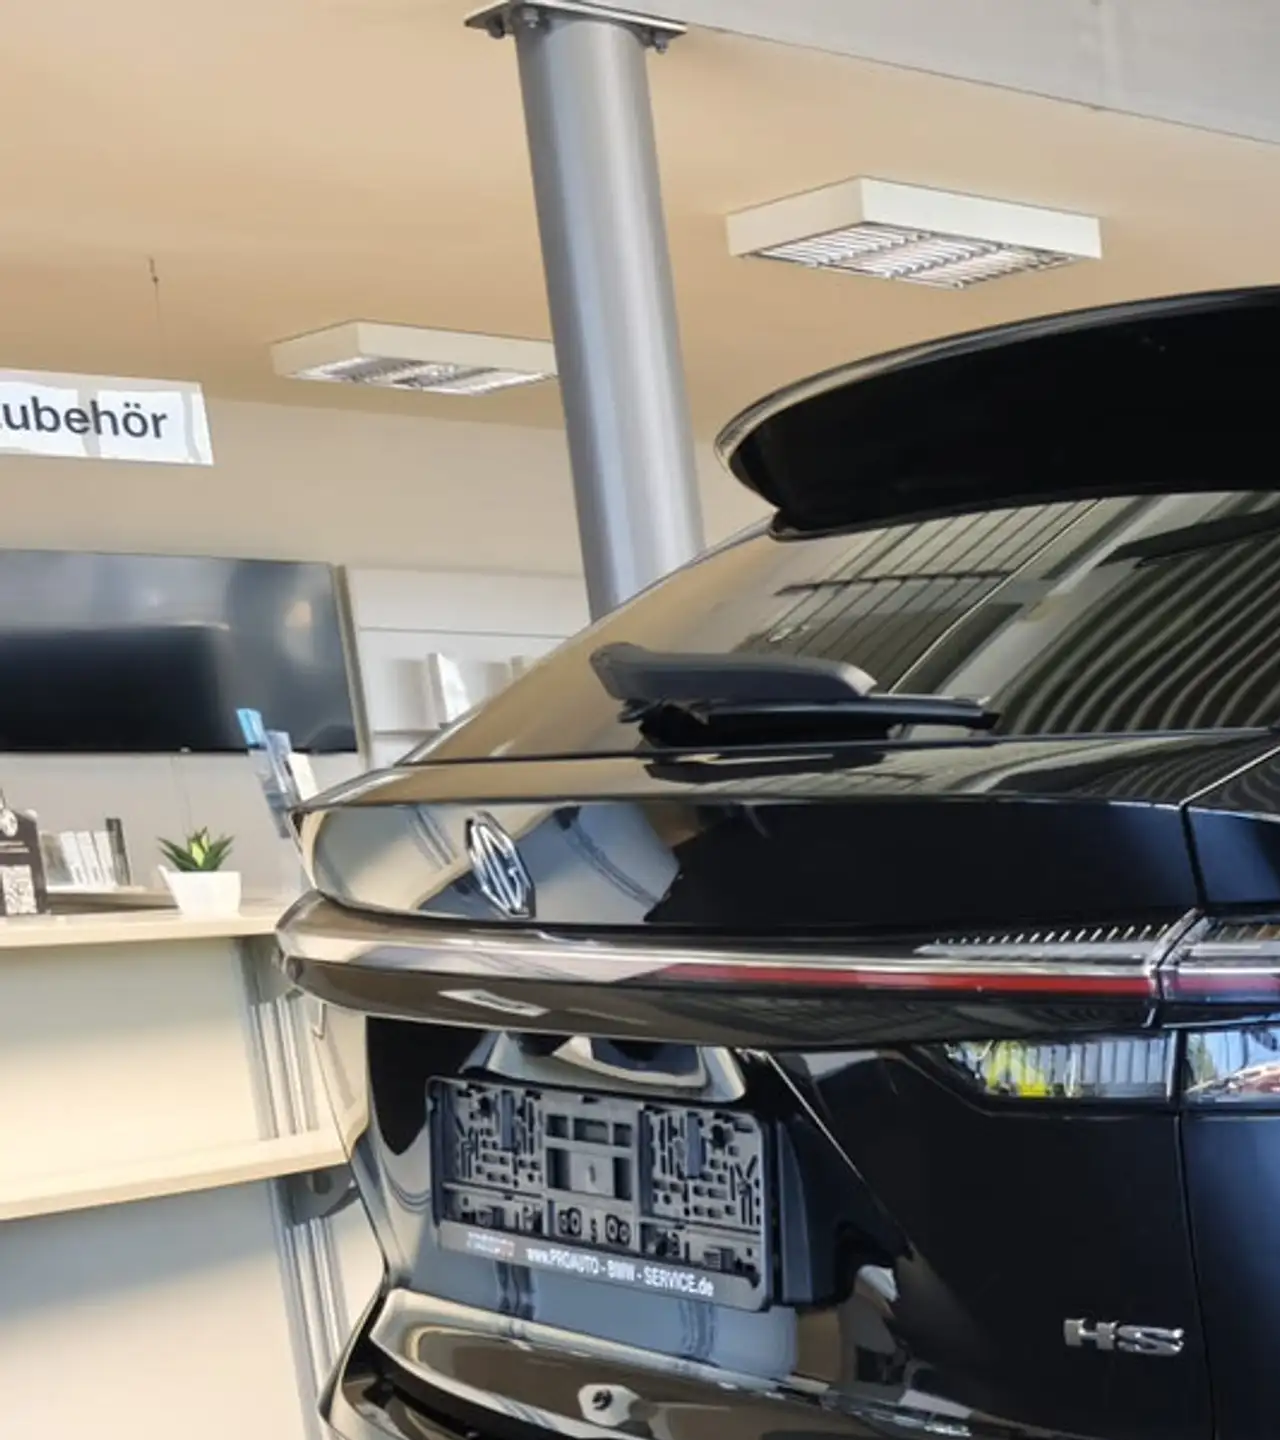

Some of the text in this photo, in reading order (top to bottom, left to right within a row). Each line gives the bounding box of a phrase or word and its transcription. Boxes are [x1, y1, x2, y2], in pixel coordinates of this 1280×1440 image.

[0, 395, 168, 439] ubehör
[607, 1259, 635, 1282] BMW
[643, 1266, 715, 1297] SERVICE.de
[1064, 1317, 1184, 1357] HS
